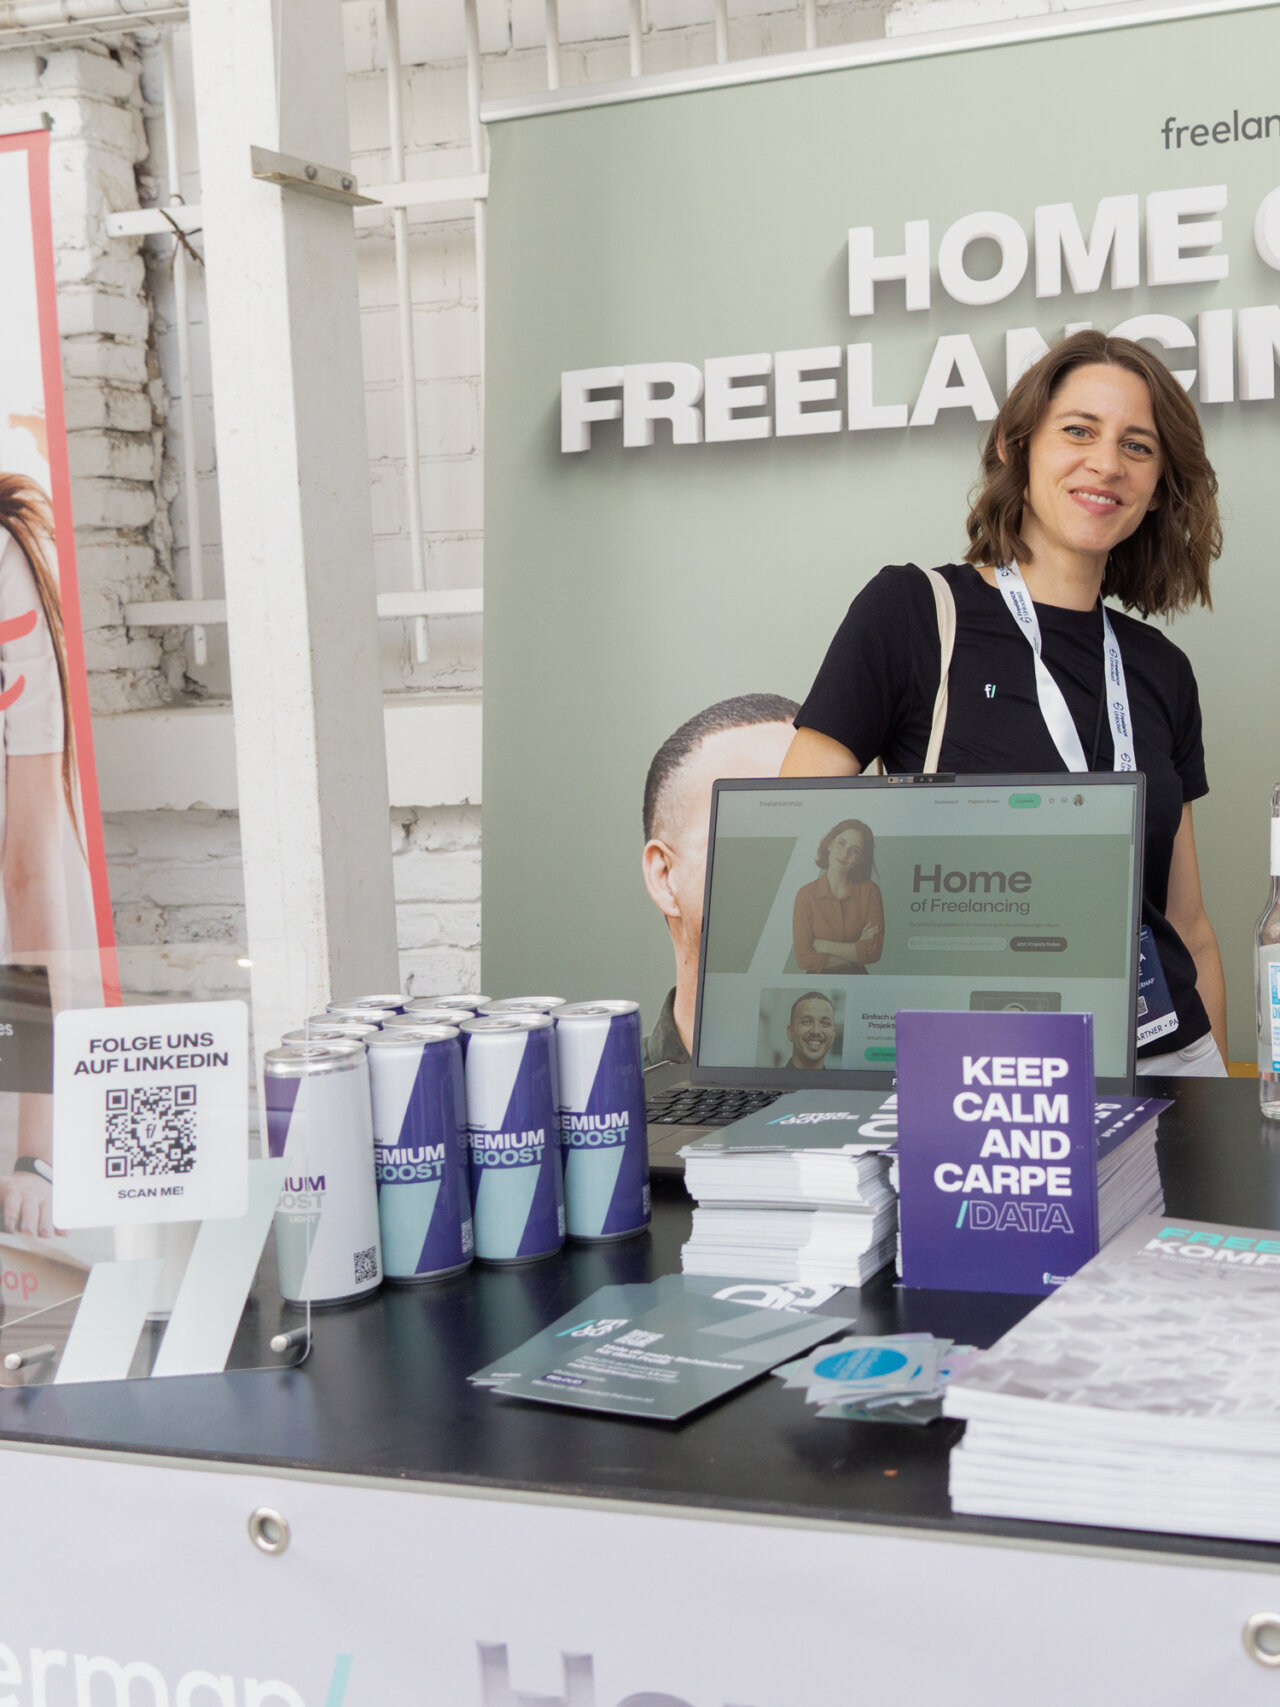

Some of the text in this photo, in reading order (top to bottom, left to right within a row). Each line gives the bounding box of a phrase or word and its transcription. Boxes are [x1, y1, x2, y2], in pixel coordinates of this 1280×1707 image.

[847, 184, 1230, 317] HOME
[912, 864, 1032, 894] Home
[910, 898, 1030, 916] of Freelancing
[89, 1032, 214, 1054] FOLGE UNS
[73, 1051, 229, 1076] AUF LINKEDIN
[962, 1055, 1069, 1088] KEEP
[952, 1091, 1069, 1124] CALM
[560, 1110, 629, 1131] EMIUM
[375, 1143, 446, 1165] EMIUM
[473, 1145, 545, 1166] BOOST
[979, 1129, 1071, 1160] AND
[117, 1185, 184, 1199] SCAN ME!
[933, 1163, 1073, 1196] CARPE
